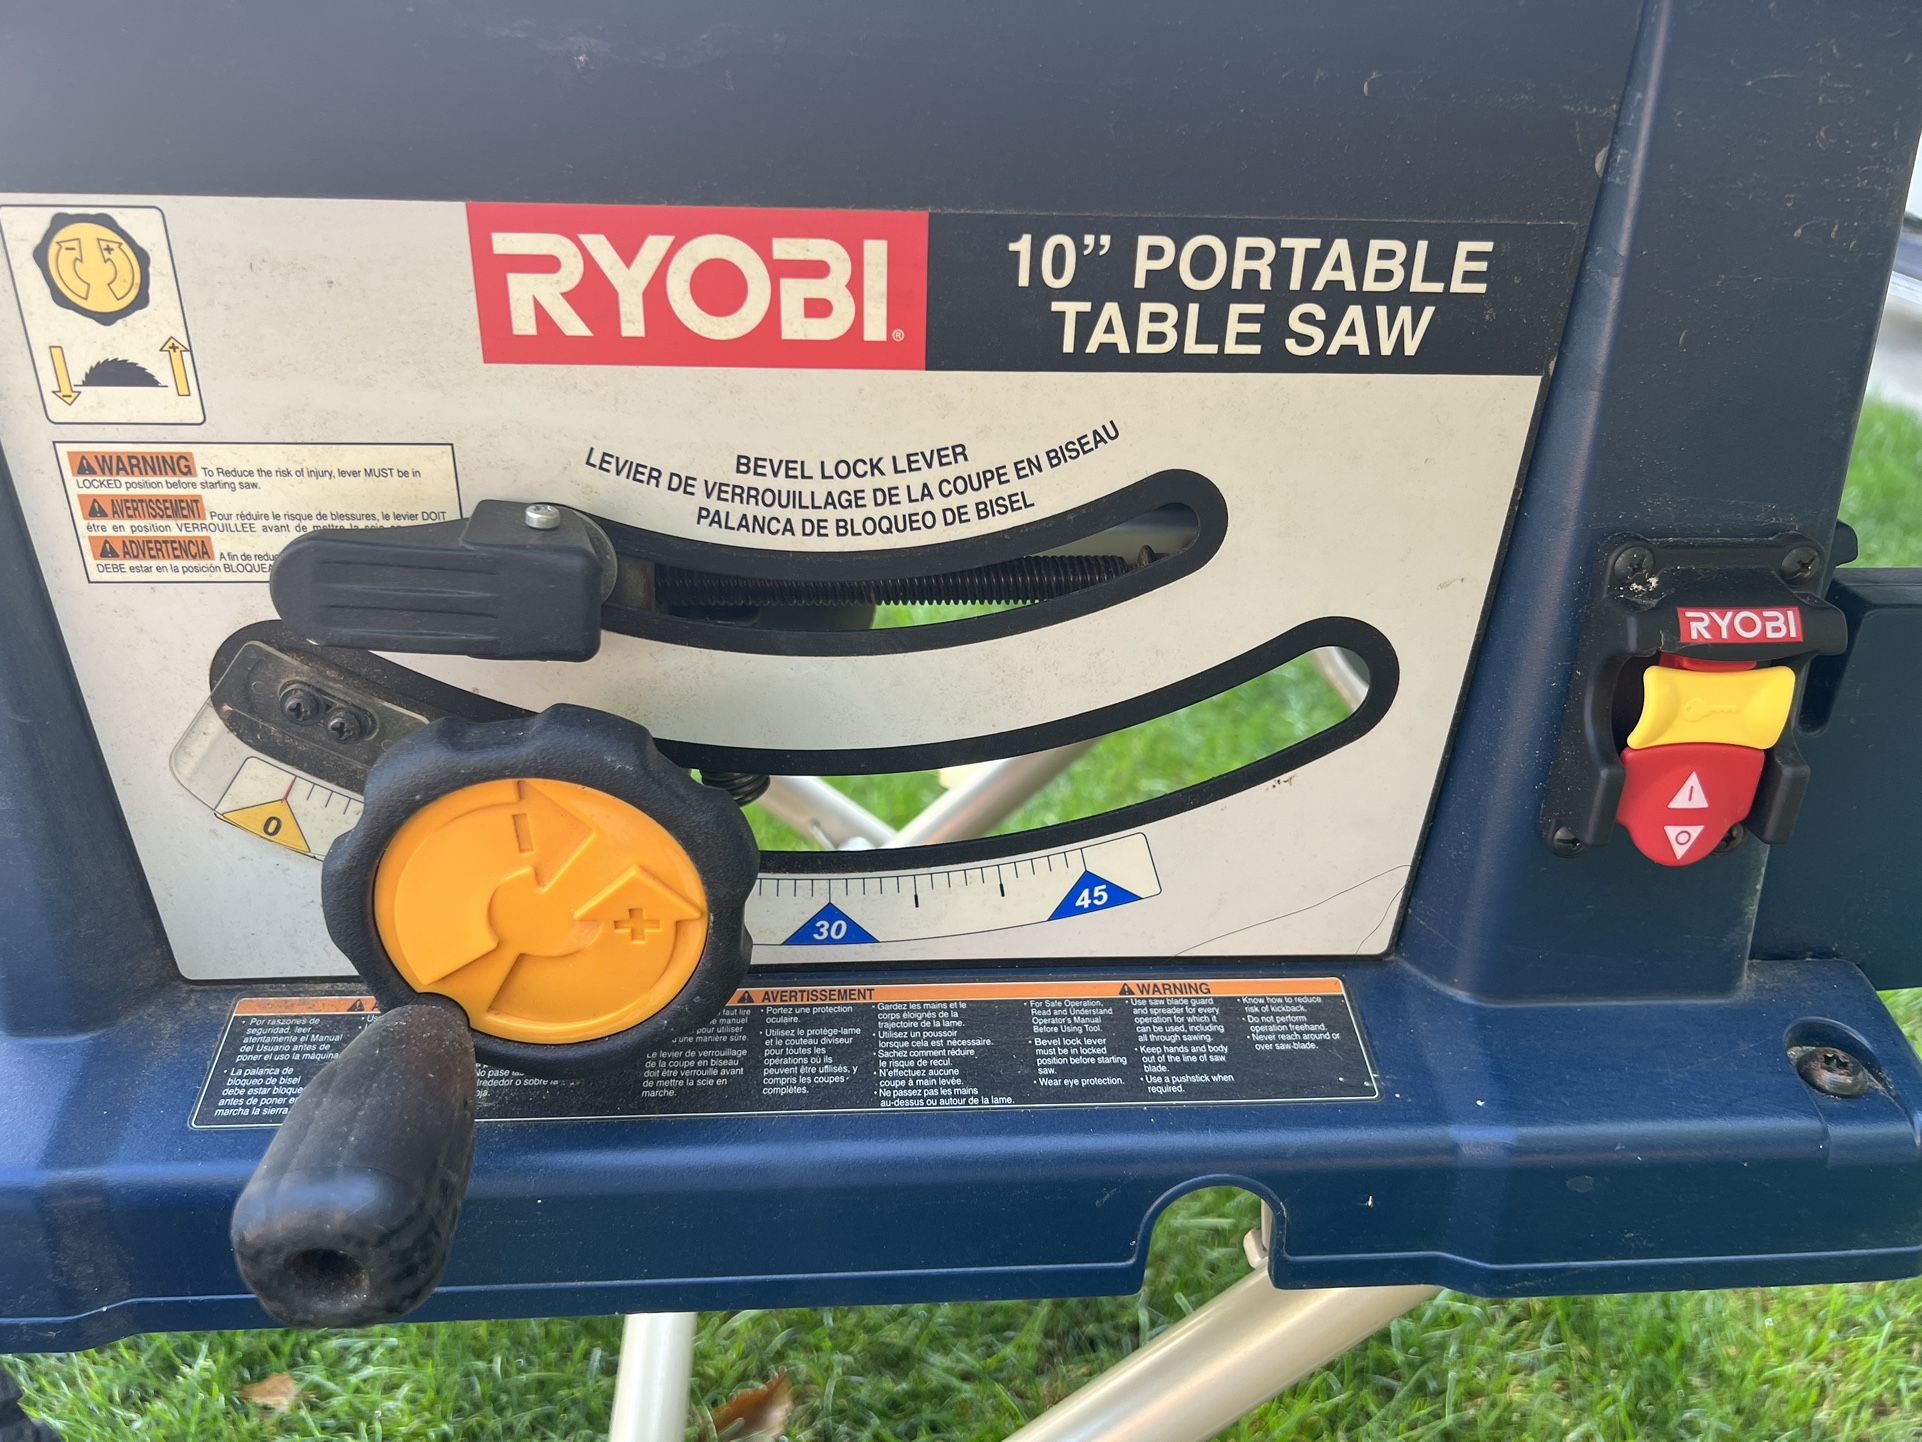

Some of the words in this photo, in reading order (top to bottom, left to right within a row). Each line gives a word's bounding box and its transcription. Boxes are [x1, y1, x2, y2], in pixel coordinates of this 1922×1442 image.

[1134, 234, 1494, 294] PORTABLE
[491, 232, 888, 341] RYOBI
[1050, 301, 1265, 355] TABLE
[1284, 304, 1436, 357] SAW
[96, 455, 192, 476] WARNING
[202, 468, 213, 477] To
[216, 468, 254, 477] Reduce
[257, 468, 272, 477] the
[275, 468, 292, 478] risk
[295, 468, 304, 478] of
[306, 468, 335, 480] injury,
[338, 468, 361, 478] lever
[364, 468, 393, 478] MUST
[397, 469, 409, 478] be
[412, 469, 421, 478] in
[585, 447, 662, 488] LEVIER
[667, 472, 697, 496] DE
[704, 480, 867, 510] VERROUILLAGE
[873, 487, 901, 507] DE
[907, 482, 934, 503] LA
[938, 465, 1010, 498] COUPE
[1013, 454, 1043, 480] EN
[1046, 420, 1120, 469] BISEAU
[736, 454, 813, 480] BEVEL
[821, 457, 885, 480] LOCK
[892, 443, 968, 474] LEVER
[76, 479, 121, 489] LOCKED
[126, 480, 163, 490] position
[167, 480, 197, 489] before
[200, 481, 236, 491] starting
[111, 499, 200, 519] AVERTISSEMENT
[210, 512, 233, 520] Pour
[236, 512, 269, 521] réduire
[272, 512, 281, 521] le
[284, 512, 313, 523] risque
[316, 512, 327, 521] de
[330, 512, 378, 522] blessures,
[382, 512, 390, 521] le
[393, 512, 418, 521] levier
[422, 512, 446, 521] DOIT
[697, 506, 795, 537] PALANCA
[802, 518, 828, 537] DE
[835, 510, 937, 537] BLOQUEO
[943, 505, 970, 527] DE
[976, 491, 1034, 520] BISEL
[113, 524, 124, 532] en
[131, 524, 171, 534] position
[176, 523, 256, 532] VERROUILLEE
[262, 523, 290, 532] avant
[295, 523, 307, 532] de
[122, 540, 210, 559] ADVERTENCIA
[219, 553, 225, 561] A
[227, 553, 238, 561] fin
[241, 553, 252, 561] de
[97, 564, 126, 573] DEBE
[130, 565, 153, 573] estar
[170, 565, 179, 573] la
[182, 564, 221, 575] posición
[1685, 610, 1798, 640] RYOBI
[263, 816, 282, 836] 0
[1074, 885, 1109, 909] 45
[813, 920, 847, 940] 30
[762, 989, 874, 1002] AVERTISSEMENT
[1137, 983, 1211, 995] WARNING
[813, 1005, 852, 1014] protection
[1303, 1032, 1330, 1040] around
[1140, 1046, 1162, 1054] Keep
[1208, 1044, 1228, 1053] body
[1037, 1057, 1068, 1066] position
[1098, 1056, 1127, 1065] starting
[1064, 1078, 1079, 1087] eye
[1082, 1077, 1124, 1086] protection.
[893, 1089, 922, 1097] passez
